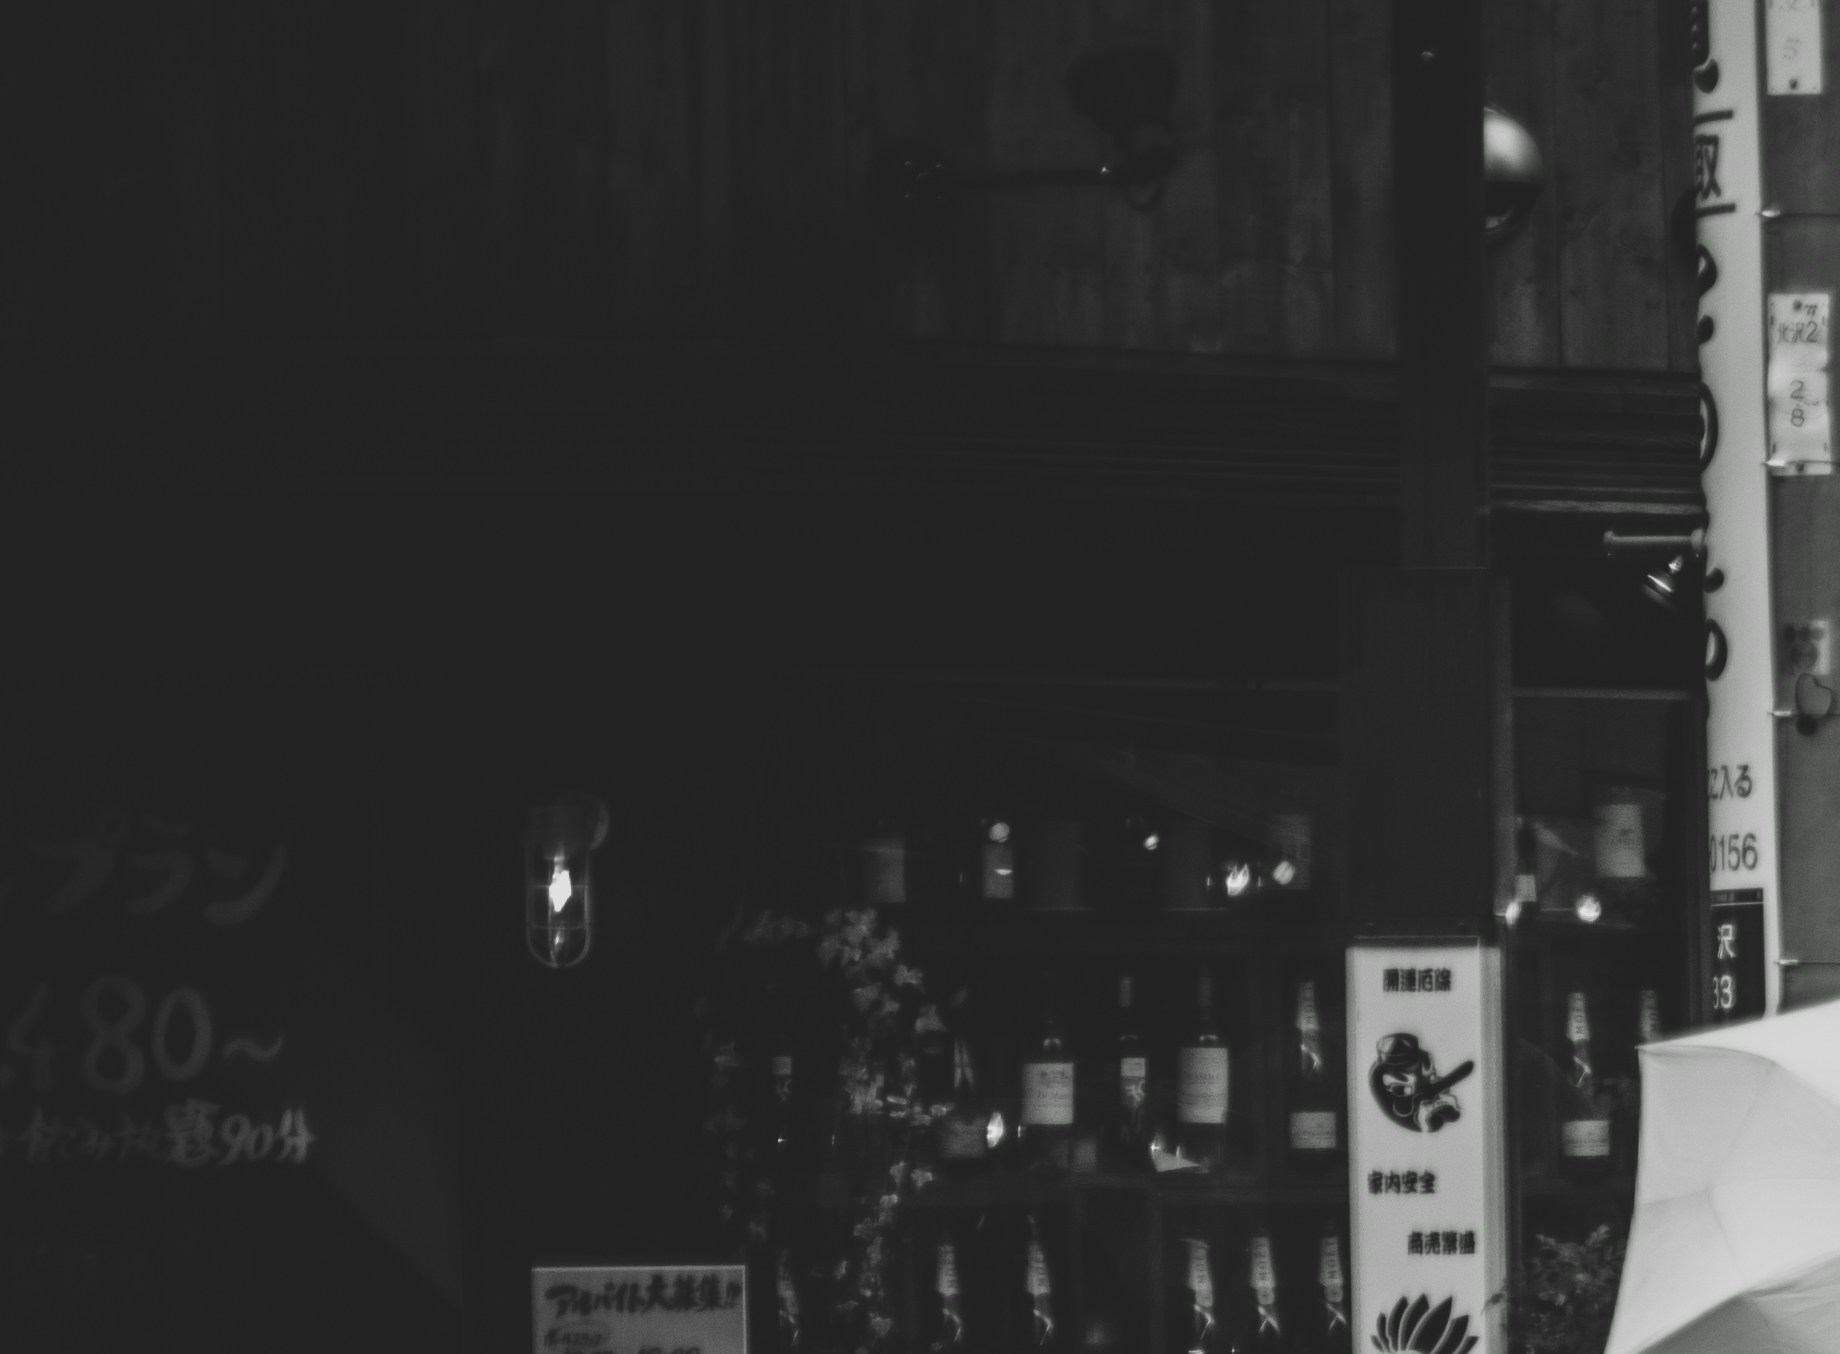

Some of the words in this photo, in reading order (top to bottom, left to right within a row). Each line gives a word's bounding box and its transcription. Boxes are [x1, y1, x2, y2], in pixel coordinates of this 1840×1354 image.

[1717, 923, 1736, 960] 沢
[1367, 1171, 1437, 1194] 家内安全
[1407, 1231, 1476, 1256] 商売繁盛
